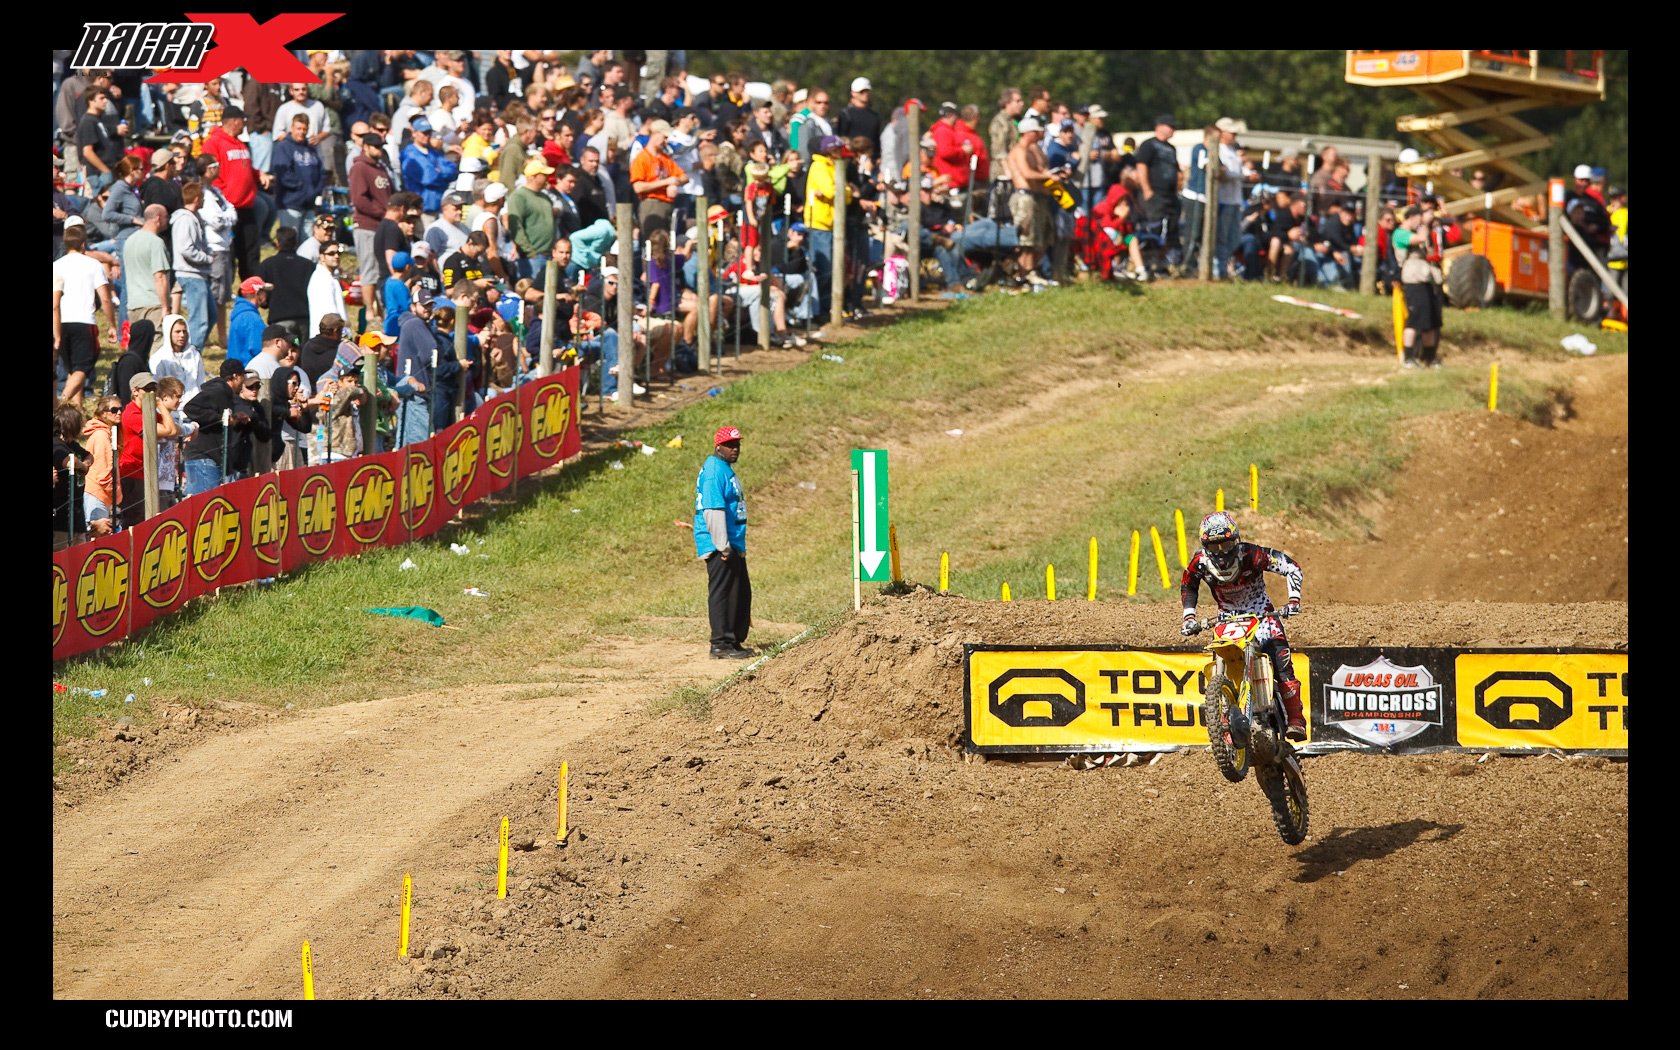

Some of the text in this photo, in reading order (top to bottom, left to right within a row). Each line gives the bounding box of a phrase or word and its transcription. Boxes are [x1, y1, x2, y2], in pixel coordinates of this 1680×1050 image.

[532, 390, 570, 445] FMF
[252, 493, 287, 547] FMF
[299, 484, 335, 536] FMF
[346, 472, 395, 528] FMF
[139, 527, 187, 595] FMF
[193, 505, 239, 566] FMF
[77, 557, 128, 619] FMF
[1220, 621, 1252, 640] 5
[1100, 670, 1206, 695] TOY
[1330, 690, 1437, 712] MOTOCROSS
[1344, 673, 1419, 688] LUCAS OIL
[1100, 702, 1207, 727] TRU
[1370, 723, 1396, 732] AMA
